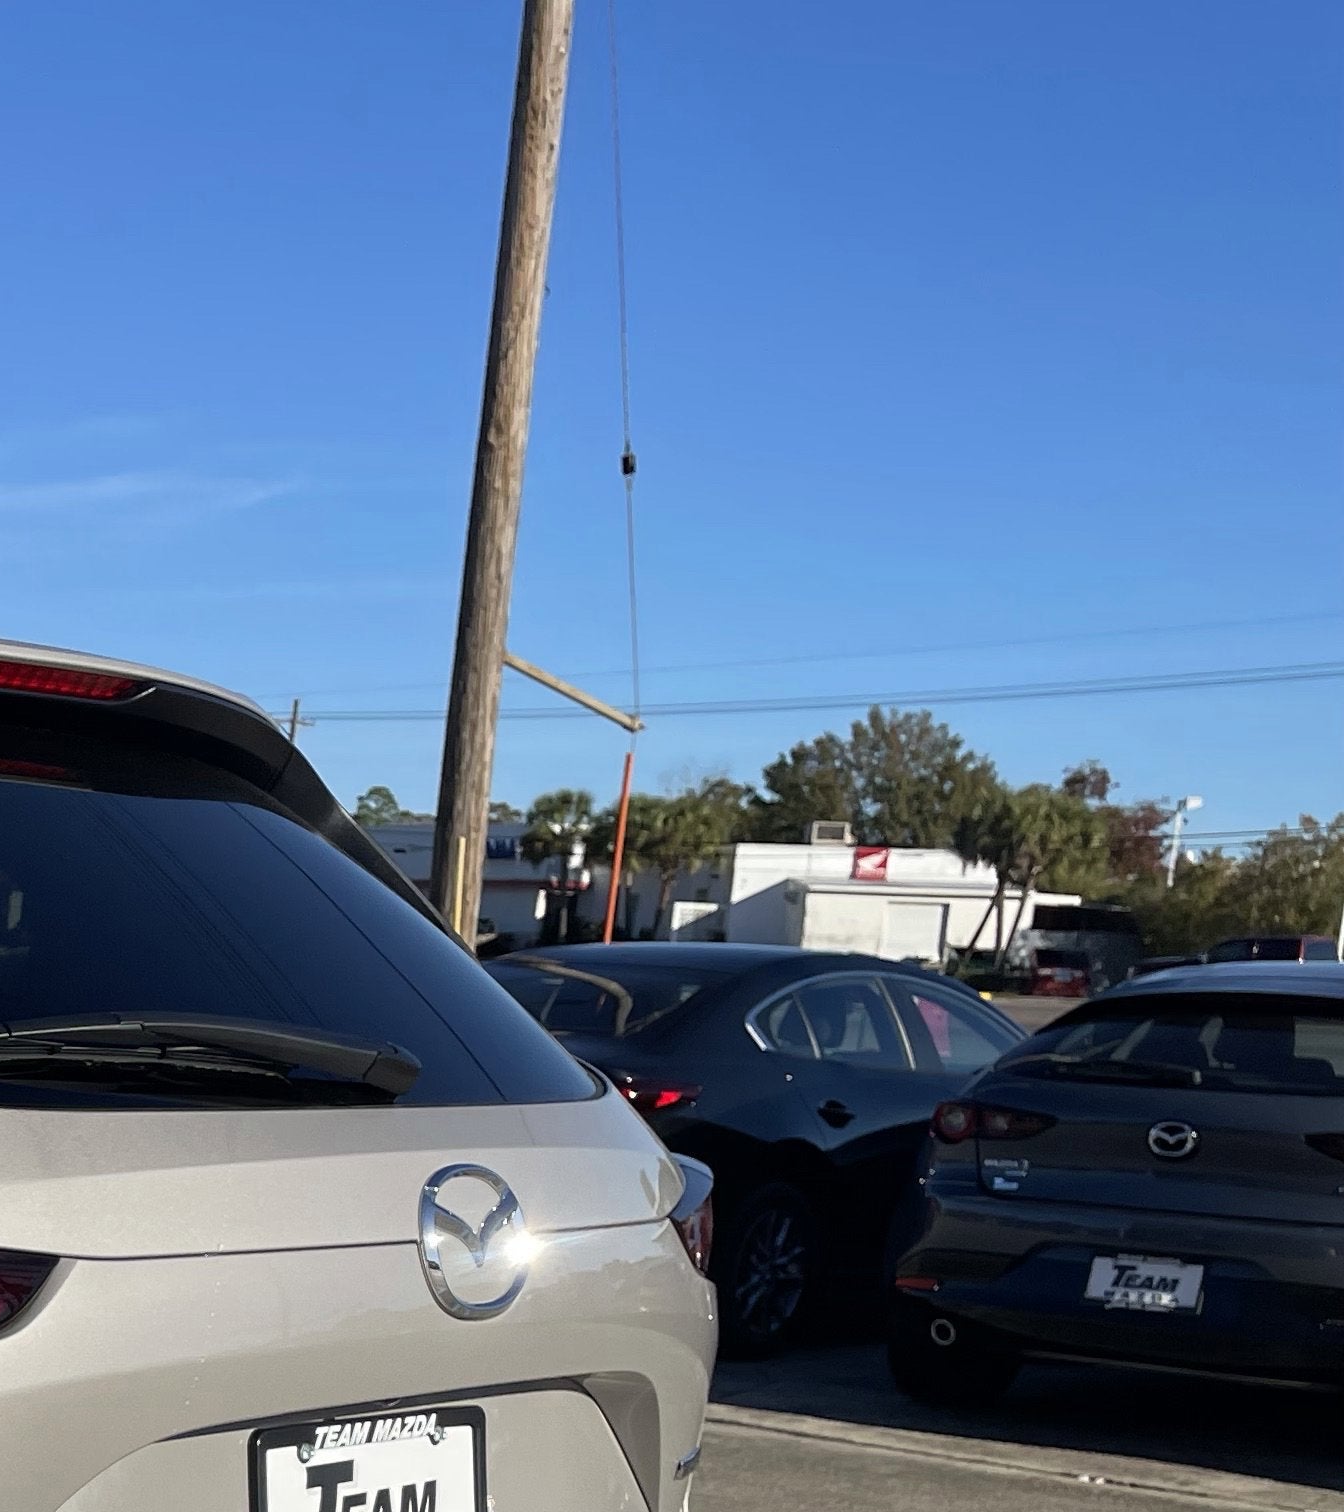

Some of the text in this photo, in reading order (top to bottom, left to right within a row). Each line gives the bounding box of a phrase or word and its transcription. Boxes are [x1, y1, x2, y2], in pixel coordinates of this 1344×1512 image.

[1111, 1264, 1181, 1293] TEAM
[314, 1413, 437, 1450] TEAM MAZDA
